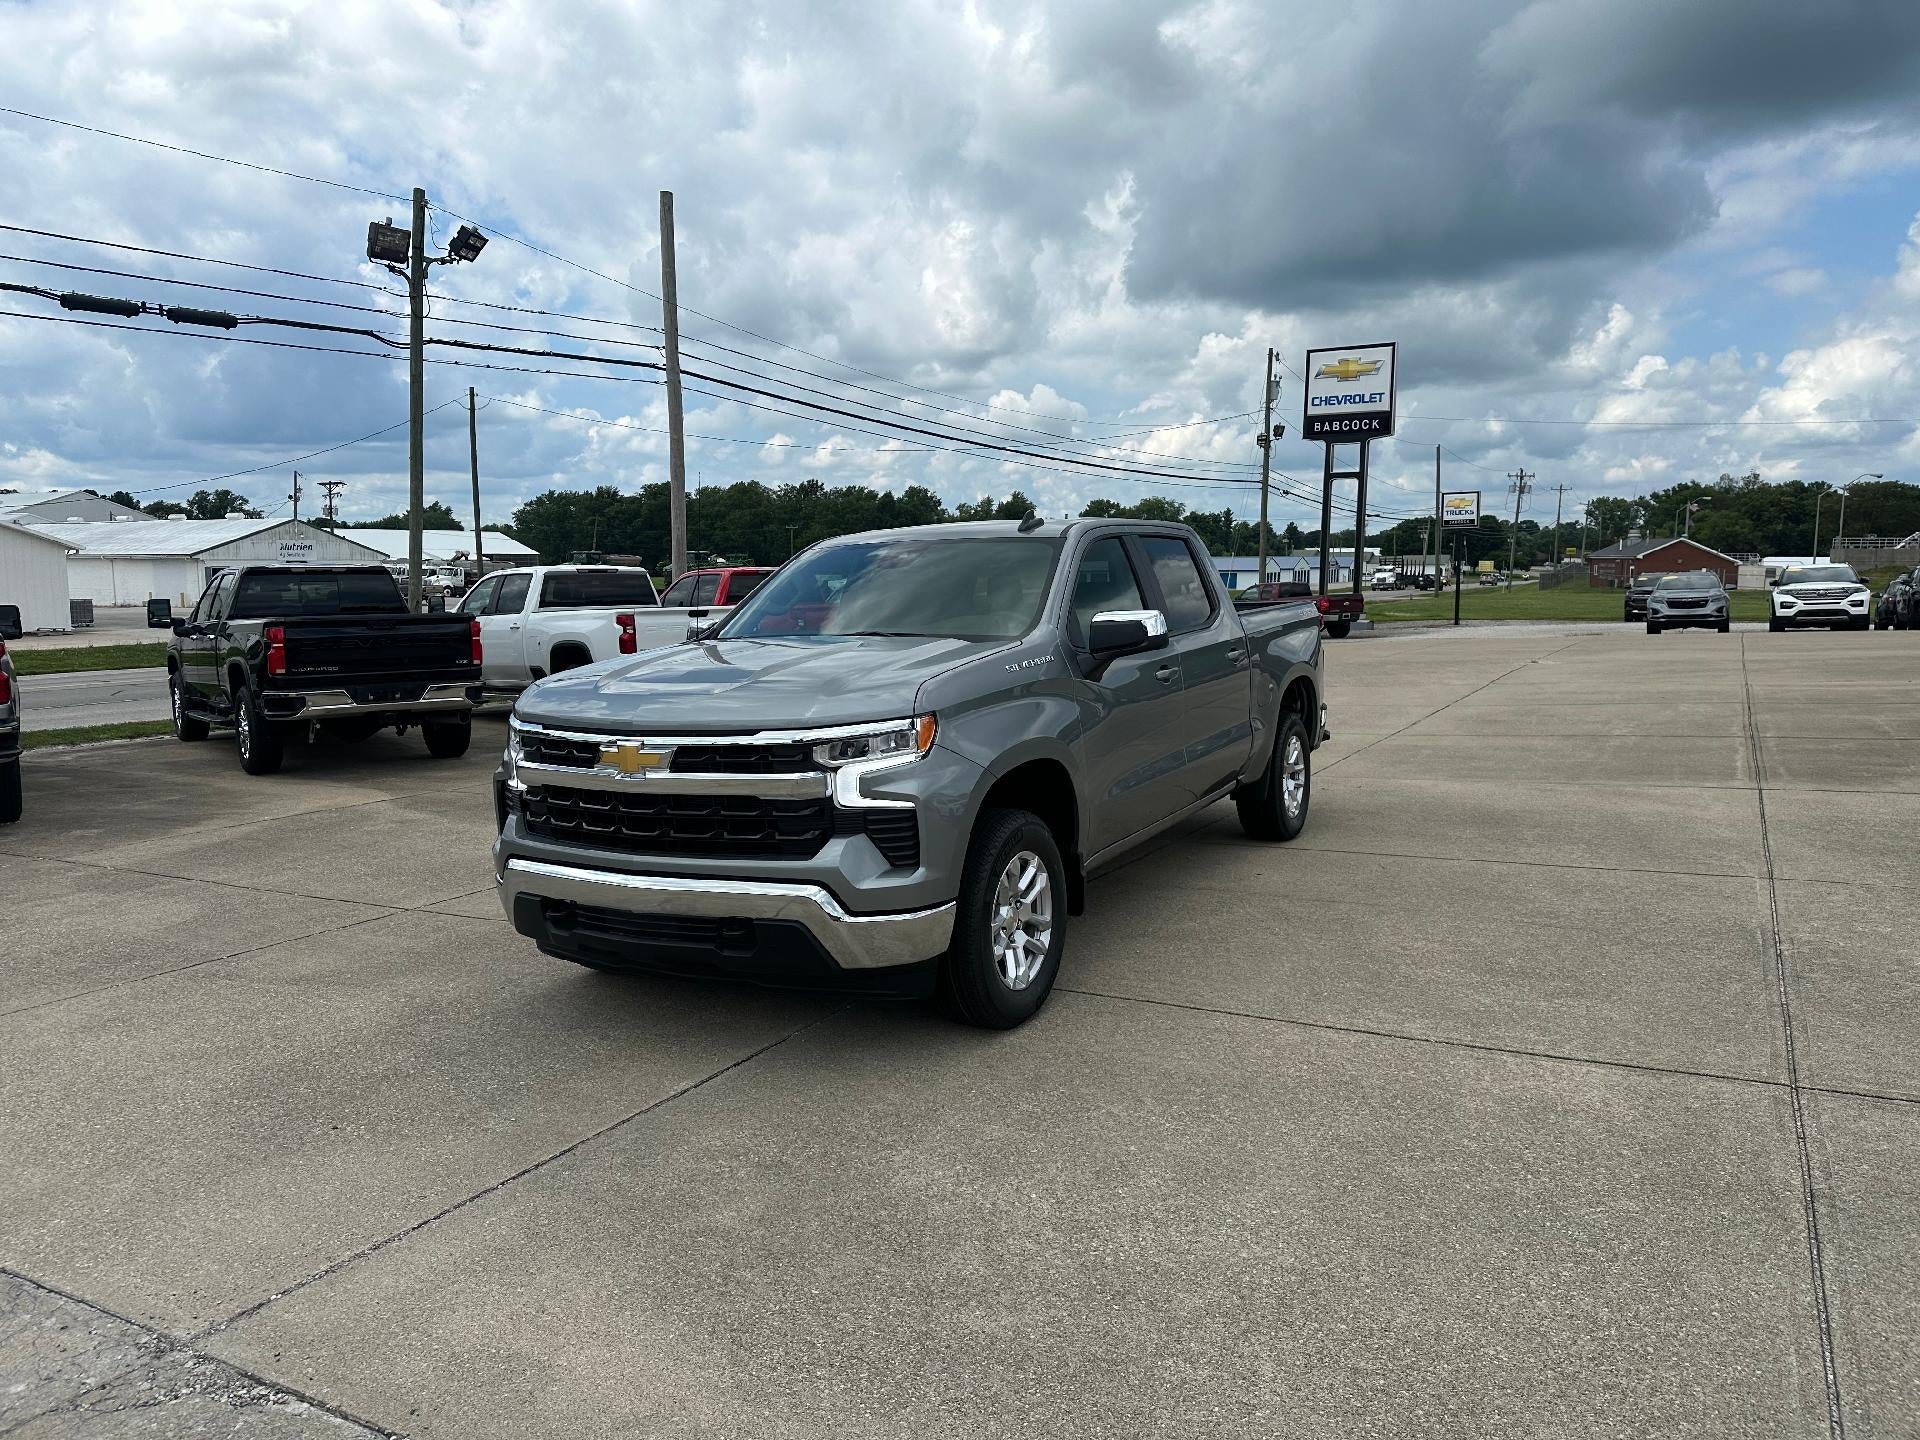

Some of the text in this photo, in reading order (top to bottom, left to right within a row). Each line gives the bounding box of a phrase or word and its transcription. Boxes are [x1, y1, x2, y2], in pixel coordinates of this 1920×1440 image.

[1311, 392, 1385, 407] CHEVROLET
[1314, 419, 1380, 432] BABCOCK
[280, 542, 313, 551] Nutrien
